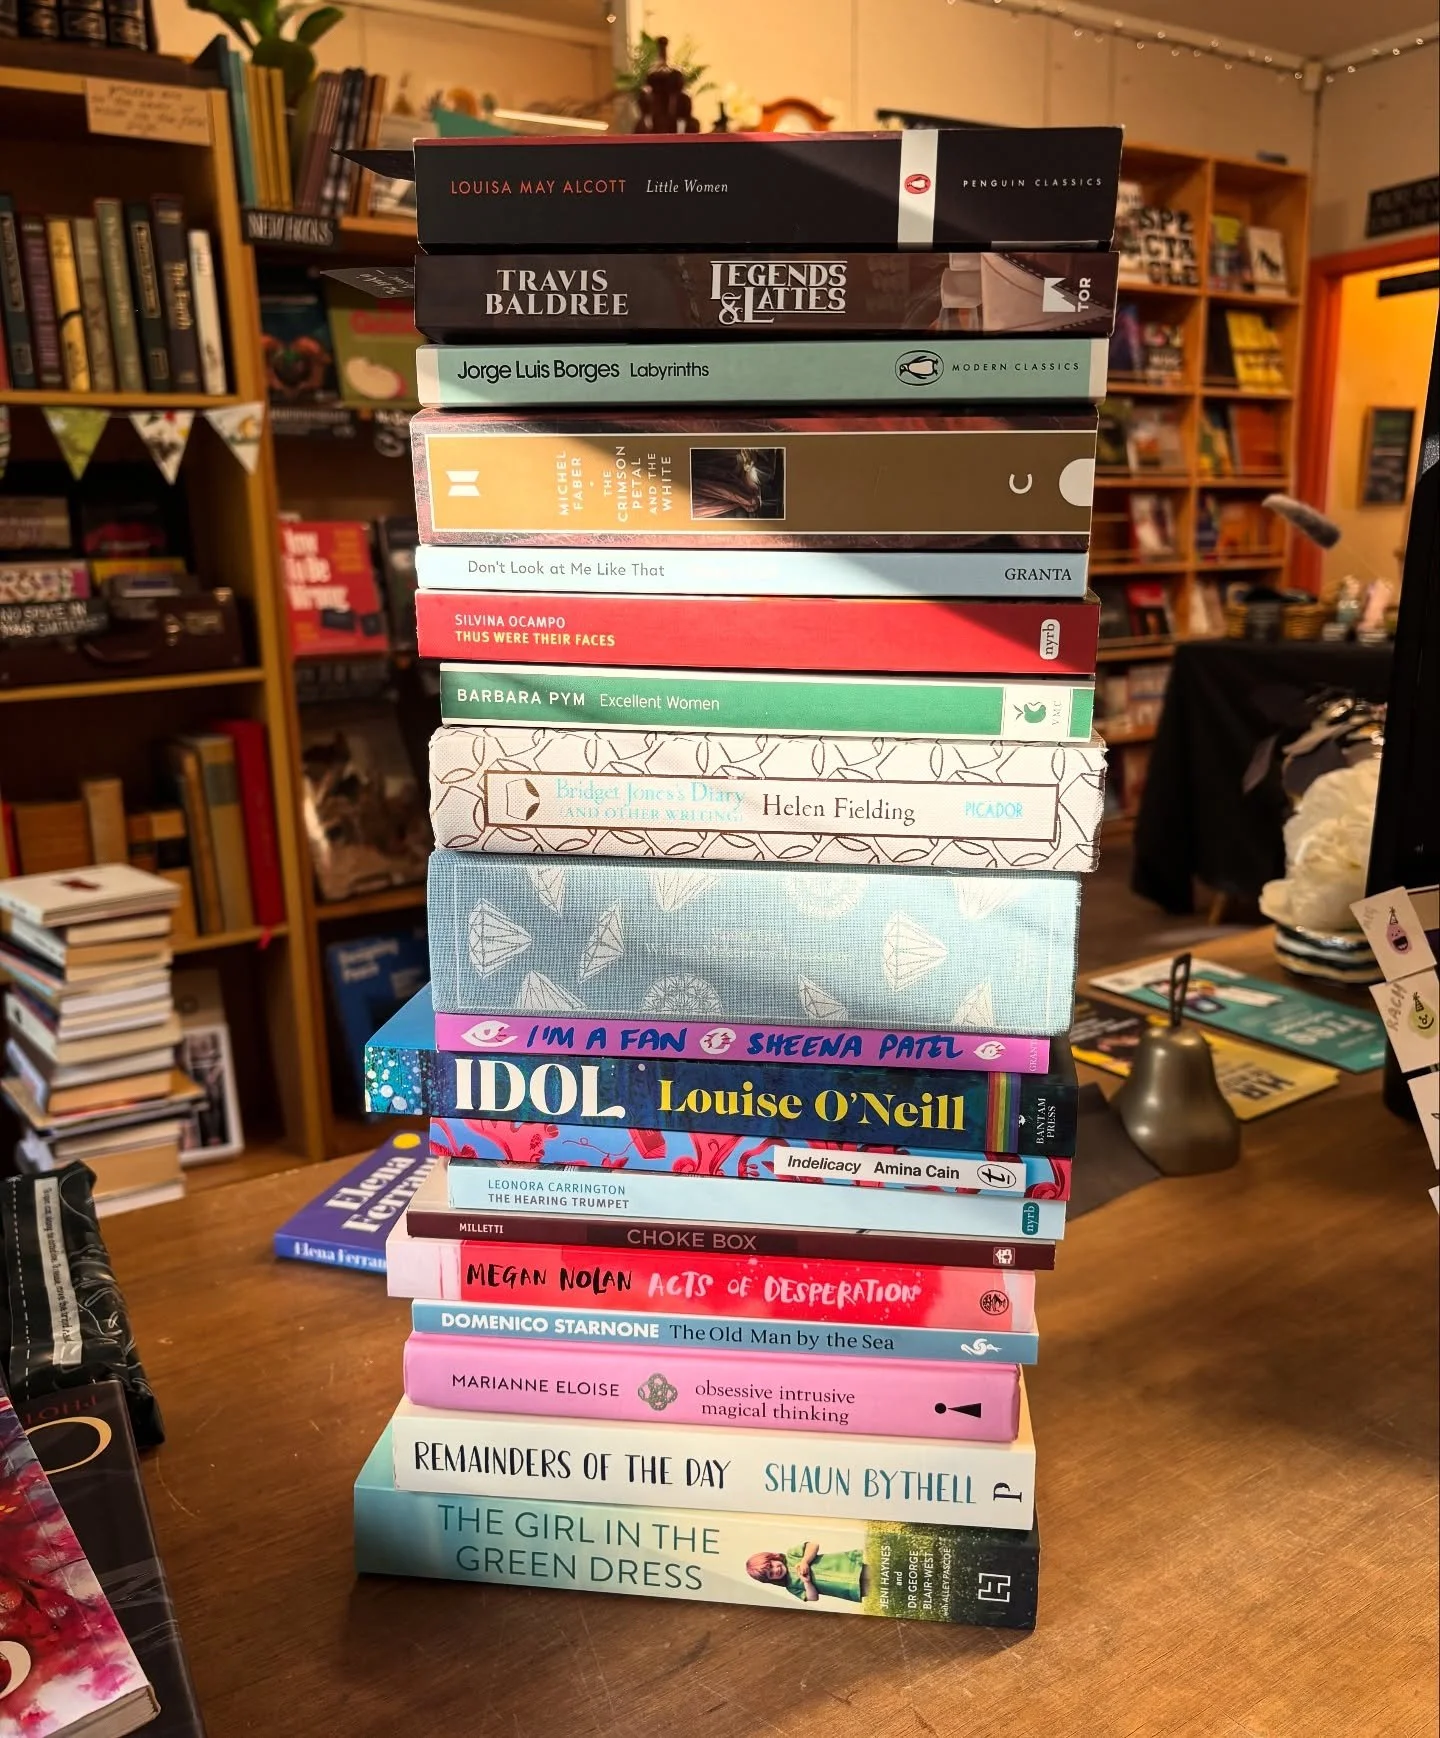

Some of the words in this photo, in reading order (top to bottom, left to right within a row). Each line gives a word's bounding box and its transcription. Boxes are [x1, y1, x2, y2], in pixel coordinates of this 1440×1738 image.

[450, 179, 511, 195] LOUISA
[520, 179, 556, 195] MAY
[563, 179, 627, 194] ALCOTT
[646, 179, 679, 194] Little
[683, 179, 729, 193] Women
[963, 179, 1026, 188] PENGUIN
[1034, 177, 1103, 187] CLASSICS
[496, 268, 609, 292] TRAVIS
[711, 263, 848, 300] LEGENDS
[485, 294, 630, 316] BALDREE
[744, 287, 847, 324] LATTES
[1077, 277, 1092, 313] TOR
[457, 361, 512, 384] Jorge
[515, 360, 551, 380] Luis
[553, 360, 620, 382] Borges
[630, 362, 710, 380] Labyrinths
[952, 362, 1008, 372] MODERN
[1014, 362, 1081, 372] CLASSICS
[648, 452, 657, 480] THE
[556, 450, 570, 516] MICHEL
[571, 457, 584, 511] FABER
[603, 469, 613, 497] THE
[615, 446, 629, 523] CRIMSON
[631, 457, 643, 510] PETAL
[661, 455, 673, 512] WHITE
[648, 486, 658, 516] AND
[467, 560, 506, 575] Don't
[510, 560, 545, 576] Look
[549, 563, 566, 576] at
[570, 562, 592, 576] Me
[597, 562, 627, 577] Like
[631, 562, 665, 578] That
[1004, 568, 1073, 581] GRANTA
[455, 614, 505, 628] SILVINA
[508, 615, 566, 629] OCAMPO
[455, 630, 490, 644] THUS
[494, 631, 529, 645] WERE
[533, 632, 571, 646] THEIR
[575, 633, 616, 647] FACES
[1042, 622, 1056, 656] nyrb
[457, 689, 542, 706] BARBARA
[549, 691, 585, 707] PYM
[599, 693, 662, 709] Excellent
[666, 696, 720, 711] Women
[556, 778, 620, 804] Bridget
[690, 781, 747, 811] Diary
[604, 807, 660, 819] OTHER
[763, 793, 826, 818] Helen
[834, 796, 916, 827] Fielding
[964, 800, 1024, 818] PICADOR
[526, 1024, 574, 1049] I'M
[585, 1026, 607, 1050] A
[621, 1026, 688, 1051] FAN
[747, 1032, 863, 1059] SHEENA
[879, 1039, 964, 1061] PATEL
[455, 1058, 627, 1120] IDOL
[657, 1079, 803, 1119] Louise
[814, 1089, 967, 1132] O'Neill
[1036, 1097, 1047, 1145] BANTAM
[1046, 1105, 1057, 1139] PRESS
[788, 1155, 862, 1175] Indelicacy
[874, 1161, 922, 1178] Amina
[926, 1165, 961, 1180] Cain
[324, 1156, 417, 1210] Elena
[488, 1179, 545, 1192] LEONORA
[548, 1182, 626, 1196] CARRINGTON
[488, 1193, 511, 1204] THE
[514, 1194, 568, 1207] HEARING
[571, 1197, 630, 1210] TRUMPET
[459, 1222, 504, 1234] MILLETTI
[1025, 1204, 1037, 1232] nyrb
[293, 1241, 336, 1261] Elena
[627, 1228, 705, 1249] CHOKE
[713, 1232, 757, 1251] BOX
[467, 1262, 547, 1288] MEGAN
[560, 1267, 632, 1295] NOLAN
[648, 1271, 713, 1298] ACTS
[727, 1278, 756, 1298] OF
[764, 1275, 921, 1310] DESPERATION
[441, 1312, 549, 1333] DOMENICO
[554, 1318, 659, 1339] STARNONE
[669, 1324, 706, 1342] The
[709, 1325, 744, 1343] Old
[750, 1328, 792, 1346] Man
[797, 1329, 820, 1349] by
[826, 1331, 858, 1349] the
[862, 1334, 895, 1351] Sea
[452, 1374, 549, 1393] MARIANNE
[557, 1380, 620, 1397] ELOISE
[695, 1379, 773, 1400] obsessive
[779, 1384, 856, 1405] intrusive
[701, 1402, 767, 1423] magical
[773, 1405, 849, 1427] thinking
[414, 1441, 571, 1479] REMAINDERS
[583, 1452, 612, 1481] OF
[625, 1454, 673, 1486] THE
[686, 1458, 732, 1490] DAY
[764, 1462, 851, 1497] SHAUN
[863, 1468, 977, 1505] BYTHELL
[437, 1504, 504, 1536] THE
[515, 1511, 595, 1545] GIRL
[606, 1519, 641, 1549] IN
[652, 1523, 721, 1555] THE
[456, 1545, 576, 1580] GREEN
[590, 1556, 703, 1591] DRESS
[880, 1545, 892, 1586] HAYNES
[894, 1571, 903, 1586] and
[908, 1550, 919, 1594] GEORGE
[923, 1551, 935, 1610] BLAIR-WEST
[879, 1586, 889, 1610] JENI
[908, 1593, 917, 1609] DR
